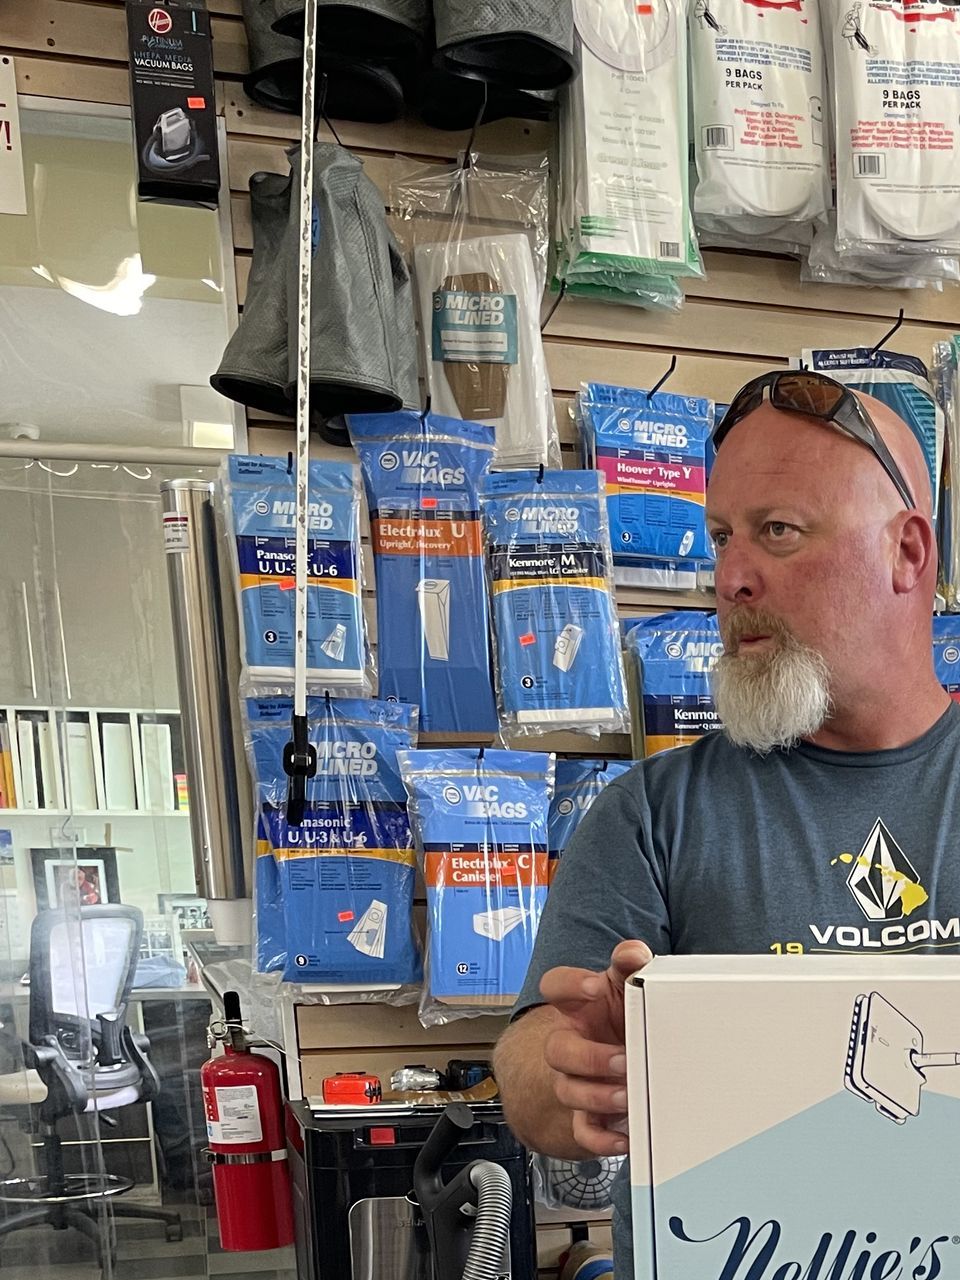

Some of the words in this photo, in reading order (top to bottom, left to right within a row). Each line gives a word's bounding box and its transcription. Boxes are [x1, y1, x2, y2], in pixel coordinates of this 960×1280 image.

[135, 58, 170, 69] VACUUM
[171, 62, 194, 72] BAGS
[725, 68, 732, 77] 9
[735, 69, 763, 81] BAGS
[725, 80, 740, 88] PER
[743, 81, 763, 91] PACK
[882, 89, 889, 100] 9
[893, 90, 921, 101] BAGS
[882, 100, 898, 109] PER
[900, 101, 921, 109] PACK
[445, 294, 505, 312] MICRO
[454, 310, 505, 326] LINED
[633, 420, 687, 436] MICRO
[640, 434, 688, 448] LINED
[401, 451, 439, 466] VAC
[415, 467, 465, 485] BAGS
[617, 462, 653, 474] Hoover
[658, 466, 680, 479] Type
[682, 467, 692, 479] Y
[521, 507, 580, 521] MICRO
[380, 525, 443, 539] Electrolux
[451, 523, 465, 539] U
[623, 532, 629, 541] 3
[380, 540, 414, 551] Upright,
[258, 560, 273, 575] U,
[313, 564, 338, 577] U-6
[509, 557, 554, 567] Kenmore
[561, 556, 576, 566] M
[267, 632, 275, 642] 3
[316, 759, 378, 776] LINED
[463, 786, 498, 803] VAC
[476, 802, 528, 819] BAGS
[287, 831, 304, 846] U,
[305, 831, 328, 844] U-3
[330, 831, 340, 844] &
[343, 831, 368, 844] U-6
[451, 857, 510, 870] Electrolux
[517, 855, 530, 870] C
[451, 870, 502, 883] Canister
[809, 918, 960, 948] VOLCOM
[770, 942, 804, 957] 19
[297, 955, 305, 966] 9
[458, 963, 469, 975] 12
